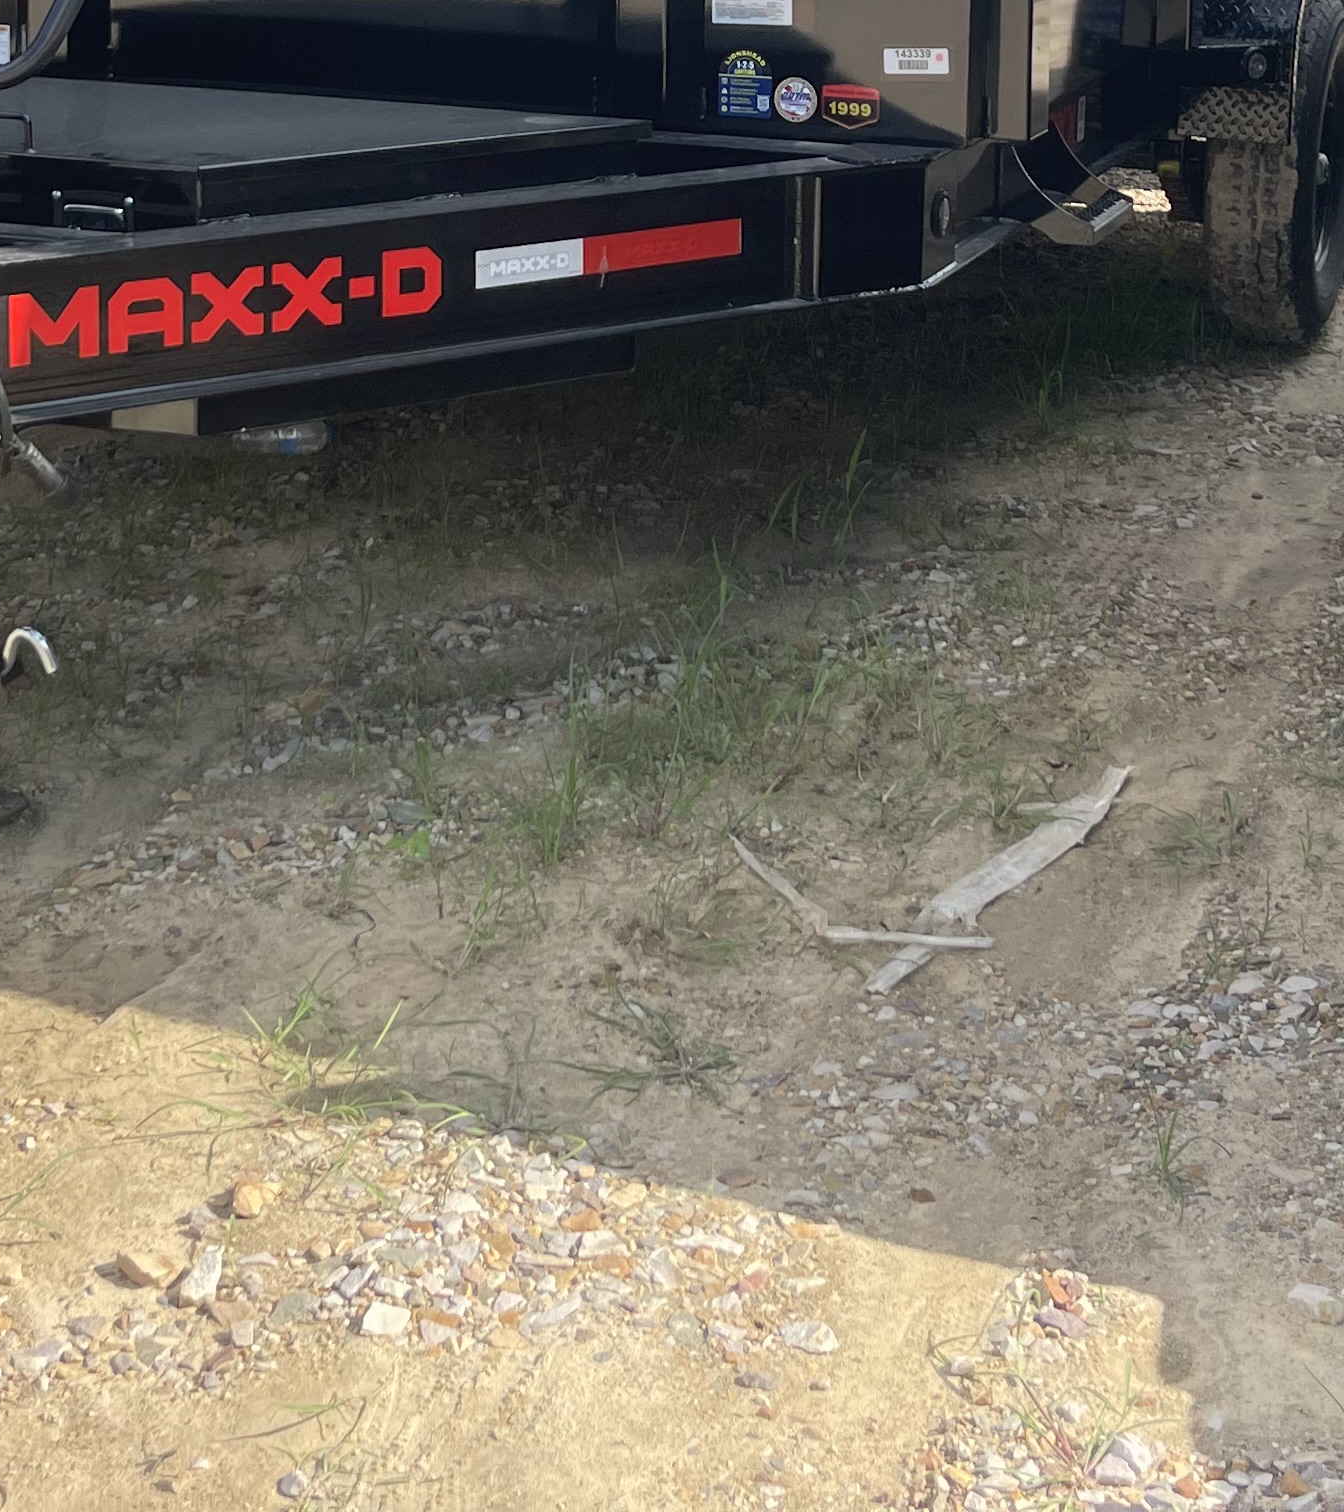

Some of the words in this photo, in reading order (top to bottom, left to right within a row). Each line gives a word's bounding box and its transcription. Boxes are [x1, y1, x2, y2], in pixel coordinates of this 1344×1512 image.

[829, 101, 872, 117] 1999
[489, 252, 570, 277] MAXX-D
[8, 246, 443, 368] MAXX-D
